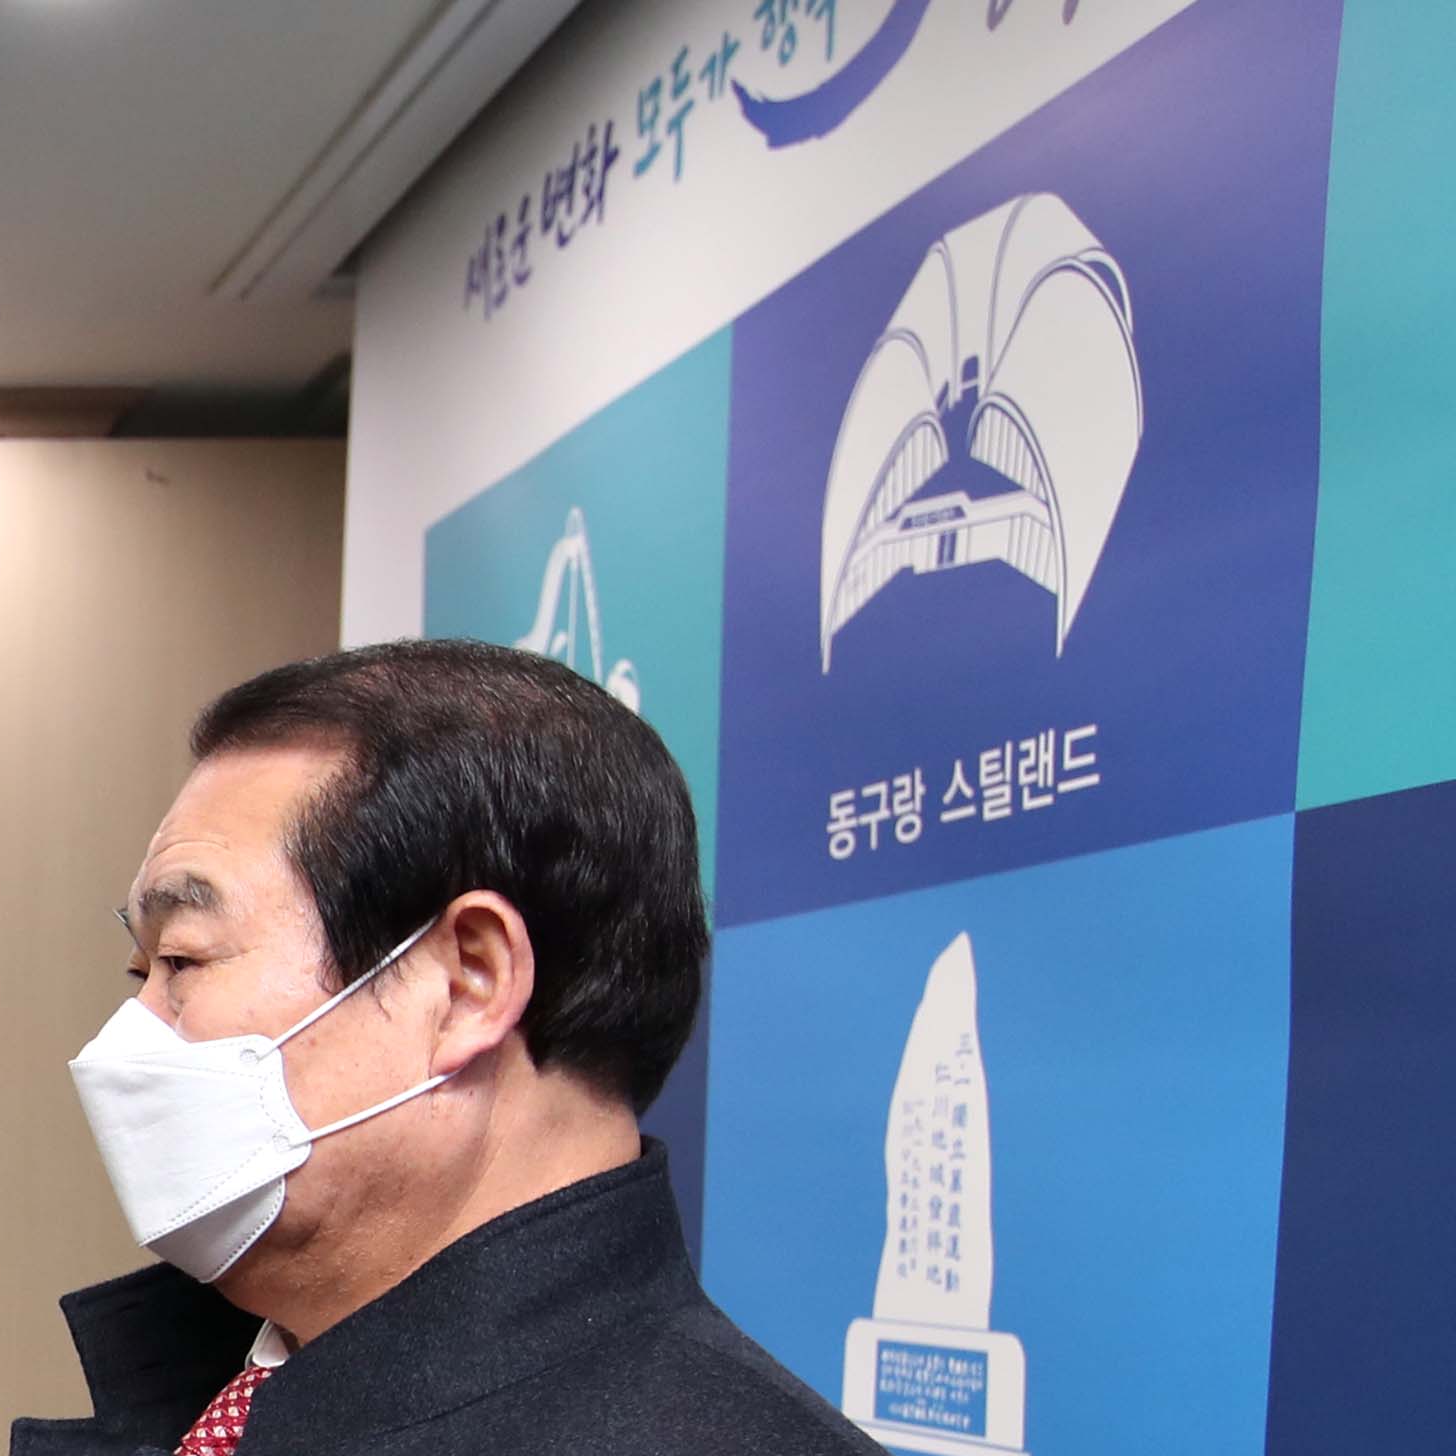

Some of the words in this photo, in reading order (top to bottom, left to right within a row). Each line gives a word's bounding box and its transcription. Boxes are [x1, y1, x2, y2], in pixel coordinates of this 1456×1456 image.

[462, 193, 533, 323] 새로운
[539, 117, 621, 249] 변화
[633, 30, 740, 183] 모두가
[825, 767, 927, 861] 동구랑
[939, 723, 1101, 822] 스틸랜드
